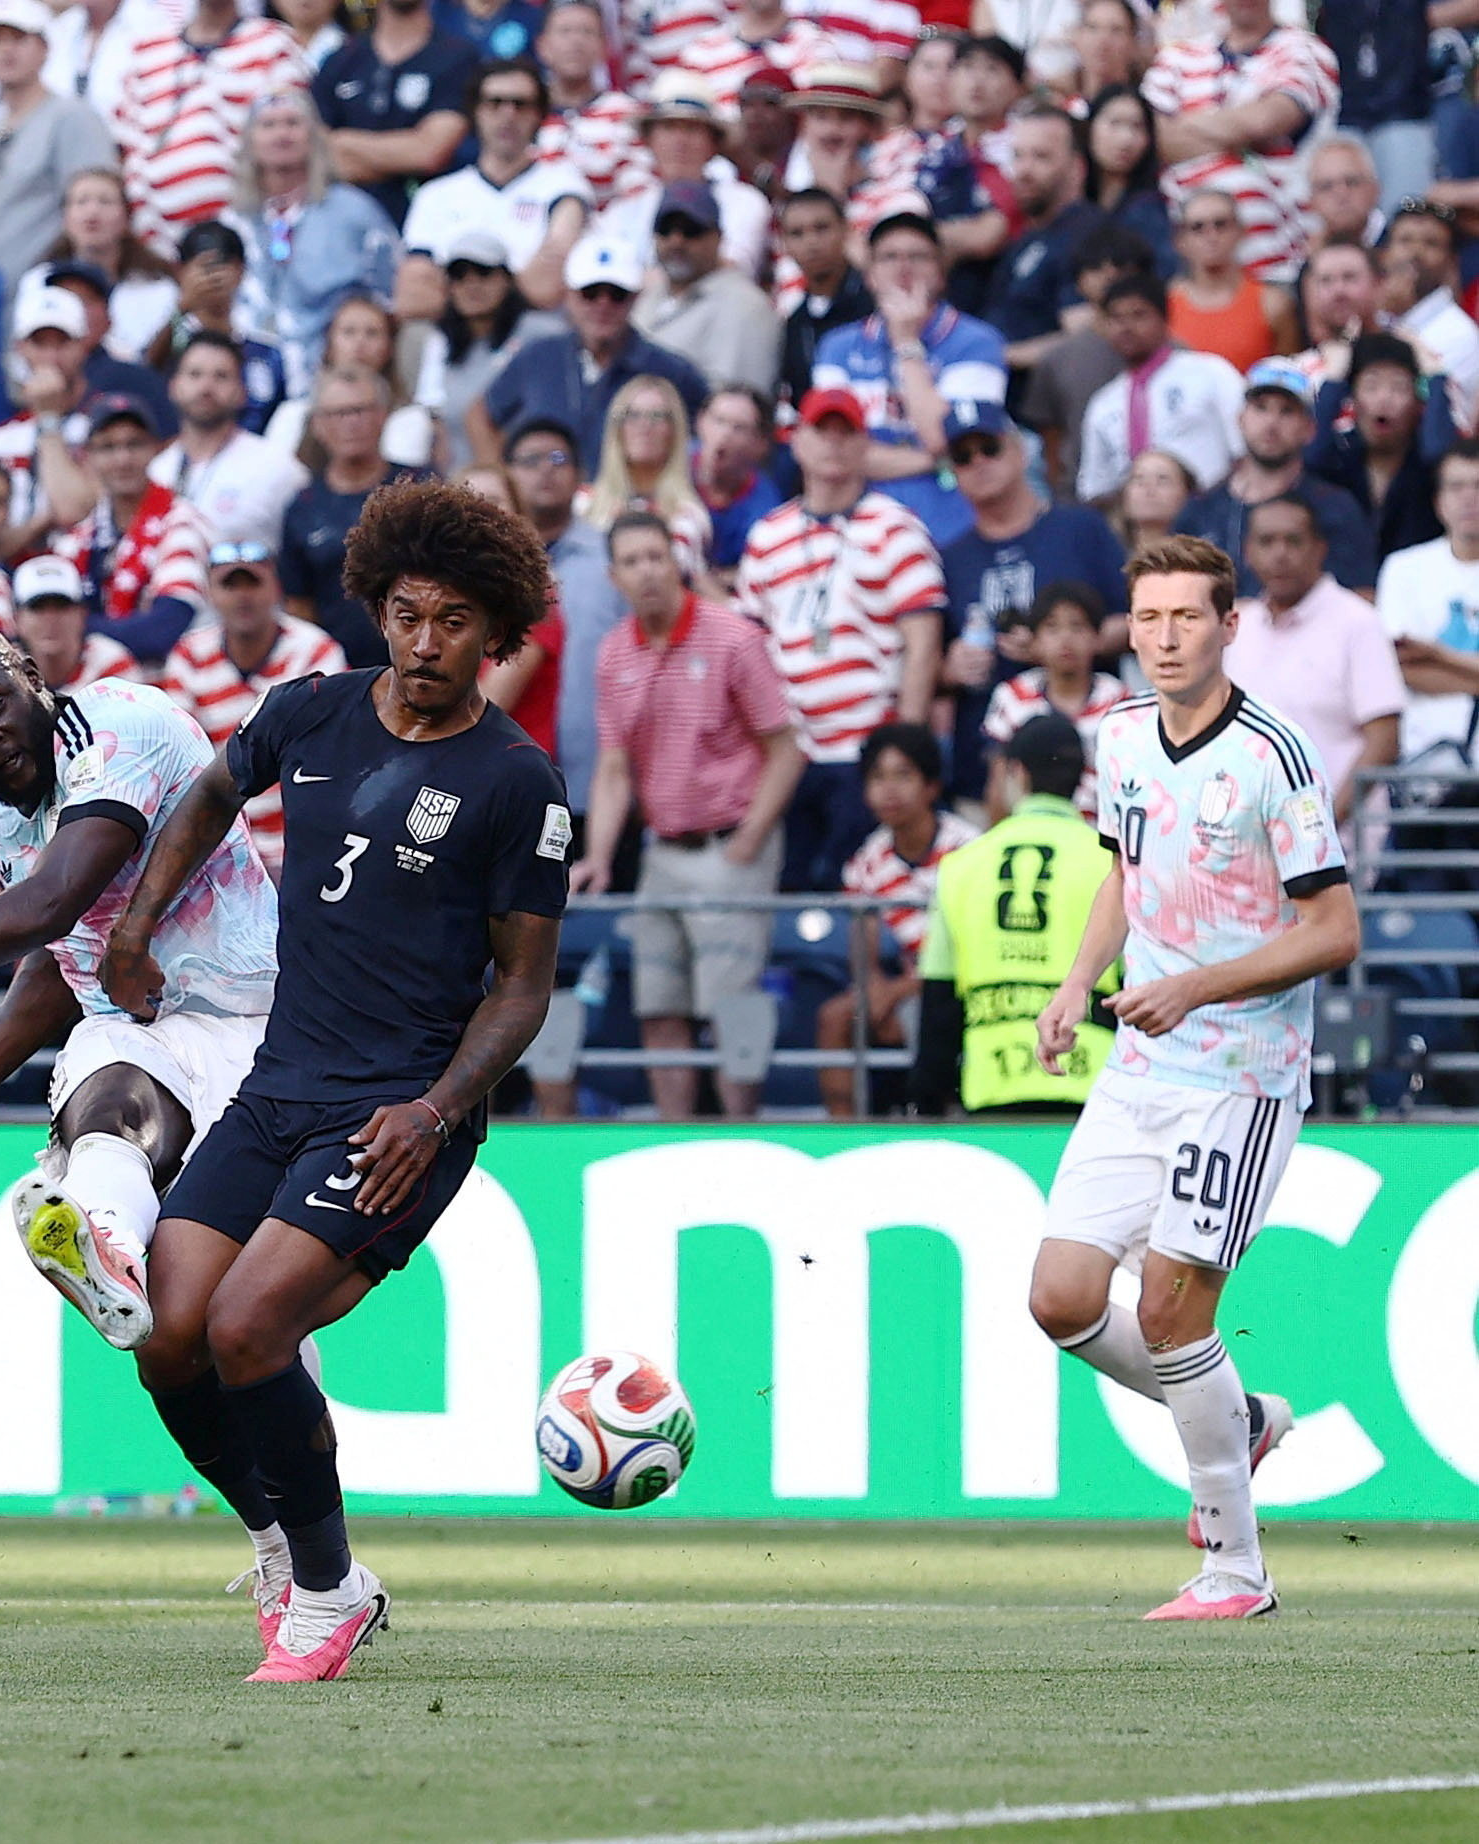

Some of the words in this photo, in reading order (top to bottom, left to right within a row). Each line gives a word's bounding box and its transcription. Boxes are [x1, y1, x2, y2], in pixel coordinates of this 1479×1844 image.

[419, 790, 456, 815] USA
[320, 833, 370, 902] 3
[993, 1043, 1089, 1078] 178
[1172, 1142, 1231, 1210] 20
